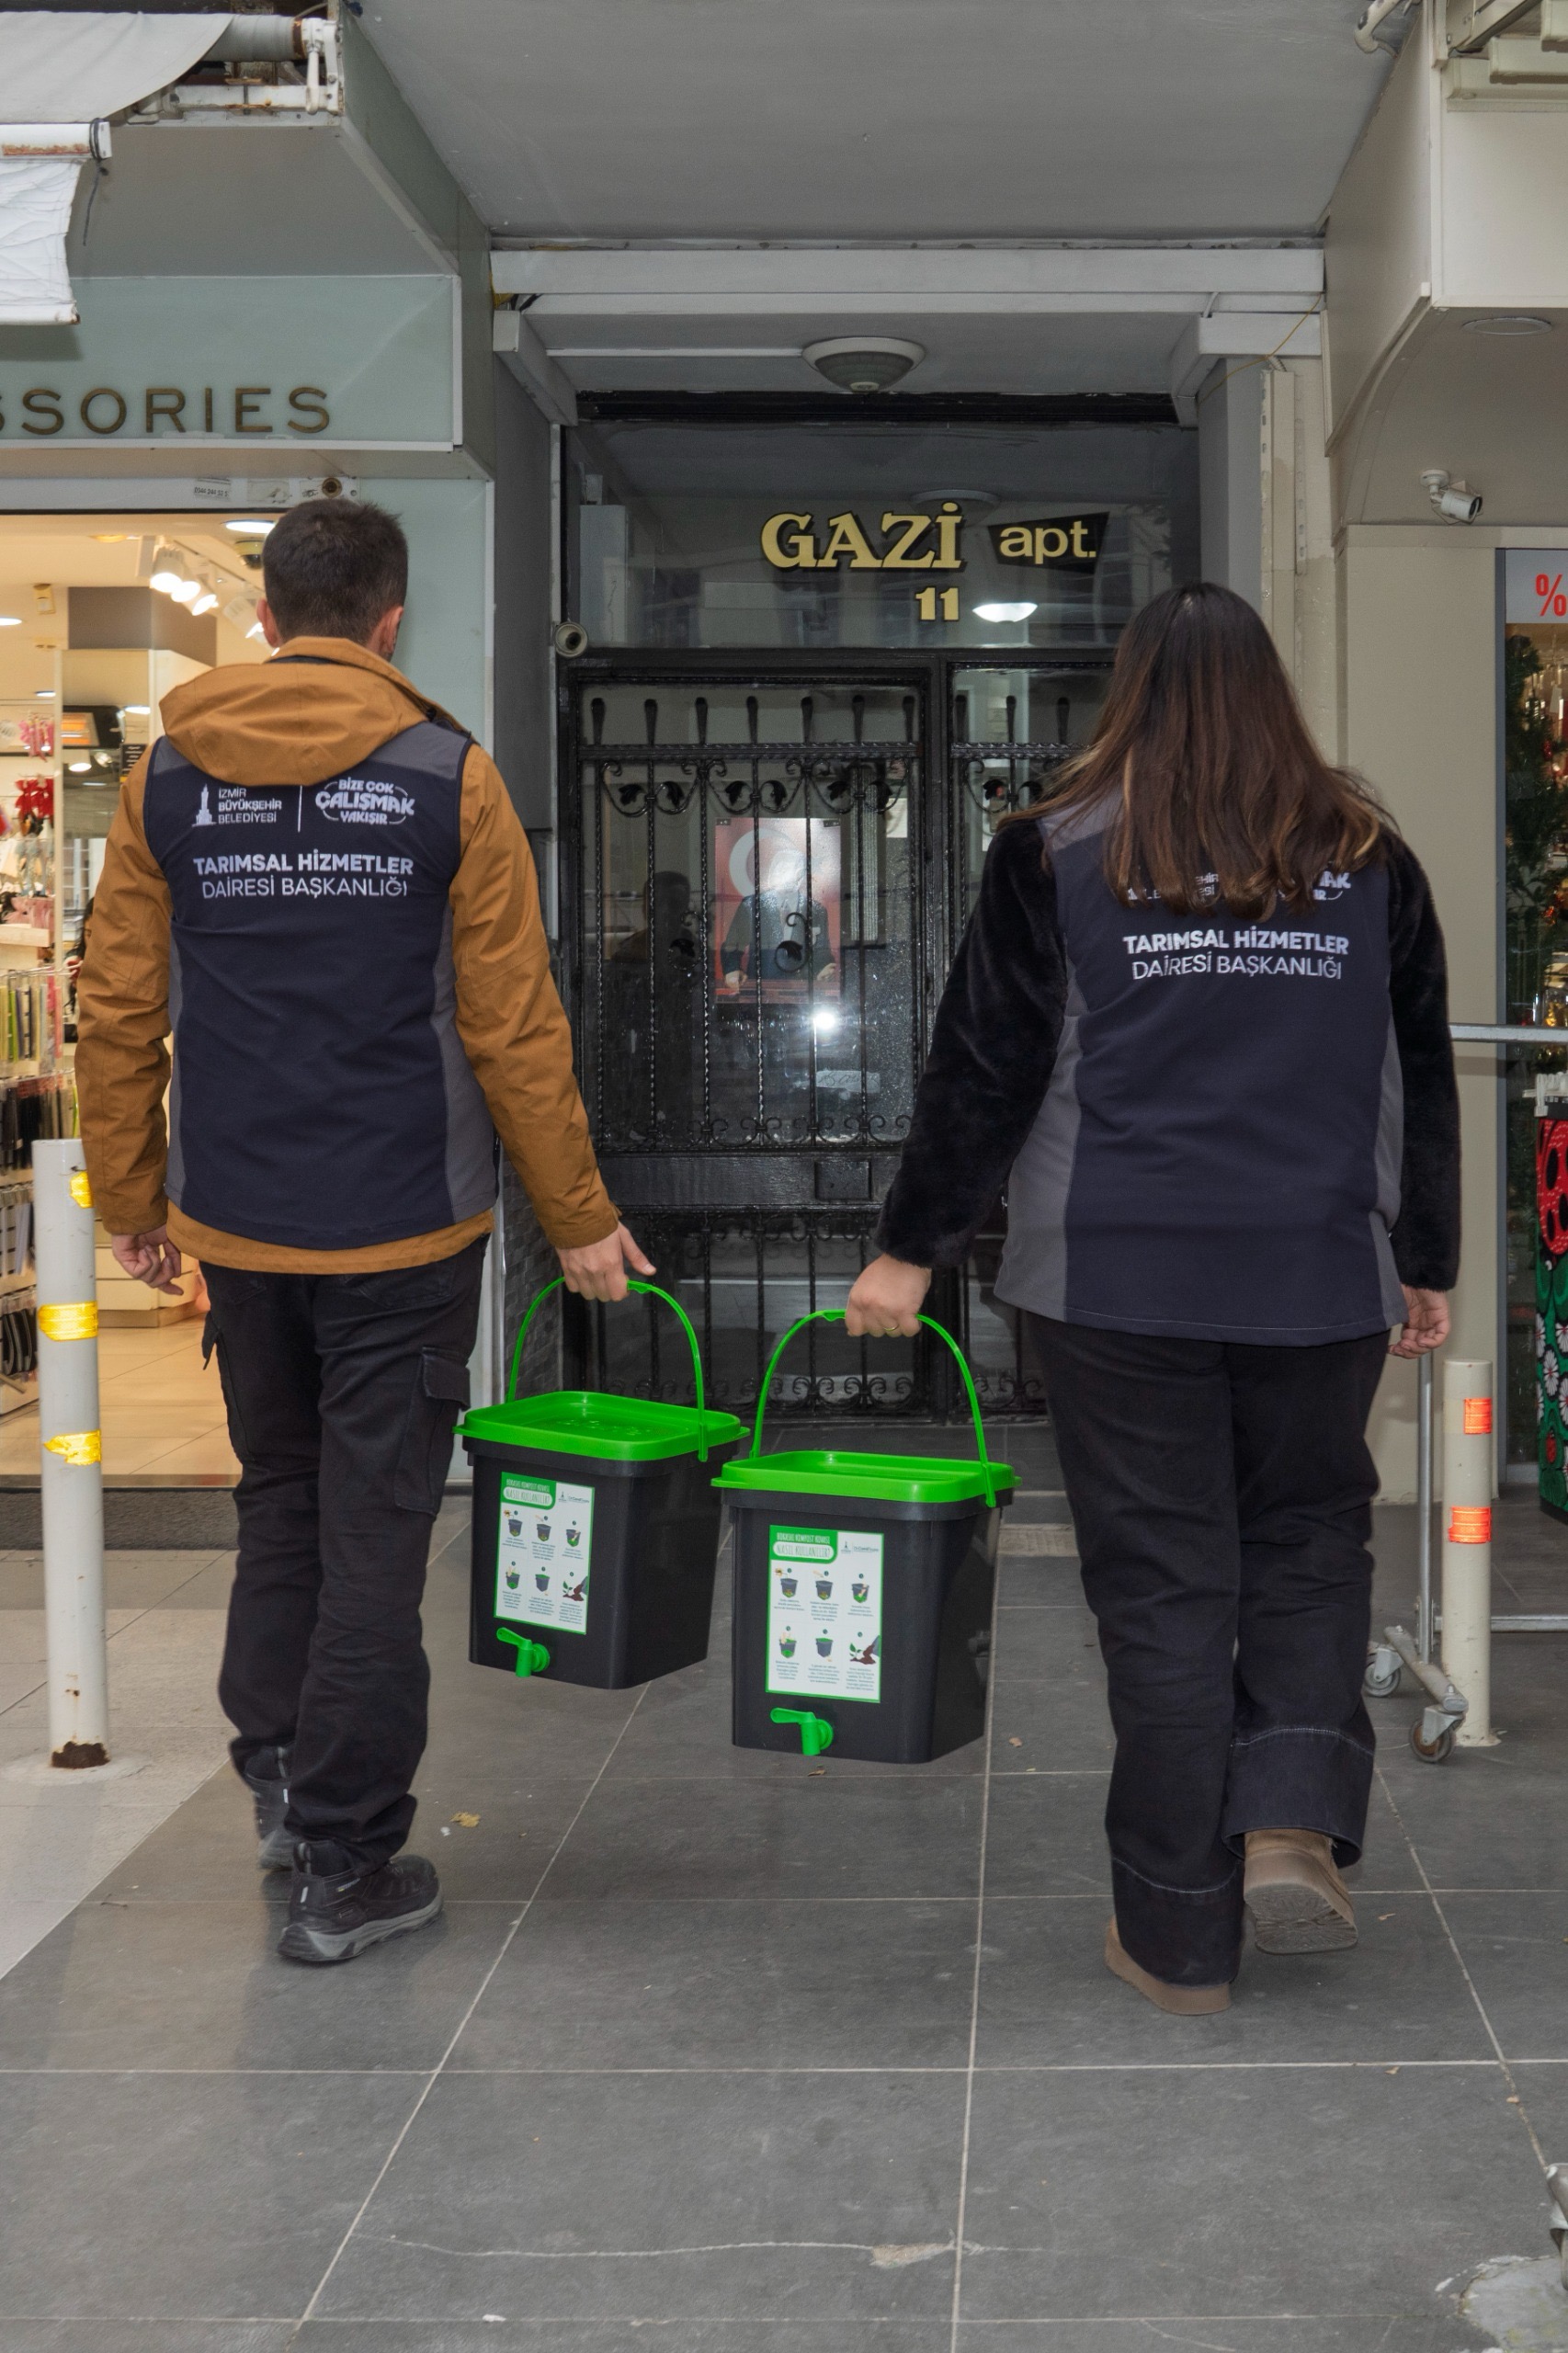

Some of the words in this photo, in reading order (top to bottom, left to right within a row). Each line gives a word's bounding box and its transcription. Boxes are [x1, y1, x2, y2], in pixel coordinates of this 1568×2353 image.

[0, 387, 330, 435] SORIES
[760, 502, 964, 570] GAZİ
[999, 521, 1097, 565] apt.
[915, 586, 960, 621] 11
[219, 787, 246, 799] İZMİR
[338, 777, 364, 791] BİZE
[366, 780, 394, 794] ÇOK
[218, 798, 282, 813] BÜYÜKŞEHİR
[315, 791, 415, 815] ÇALIŞMAK
[218, 811, 277, 824] BELEDİYESİ
[340, 810, 388, 825] YAKIŞIR
[193, 853, 293, 875] TARIMSAL
[298, 848, 414, 875] HİZMETLER
[202, 874, 276, 899] DAİRESİ
[281, 876, 408, 899] BAŞKANLIĞI
[1122, 928, 1230, 955] TARIMSAL
[1233, 926, 1349, 955] HİZMETLER
[1131, 950, 1212, 981] DAİRESİ
[1216, 955, 1342, 980] BAŞKANLIĞI
